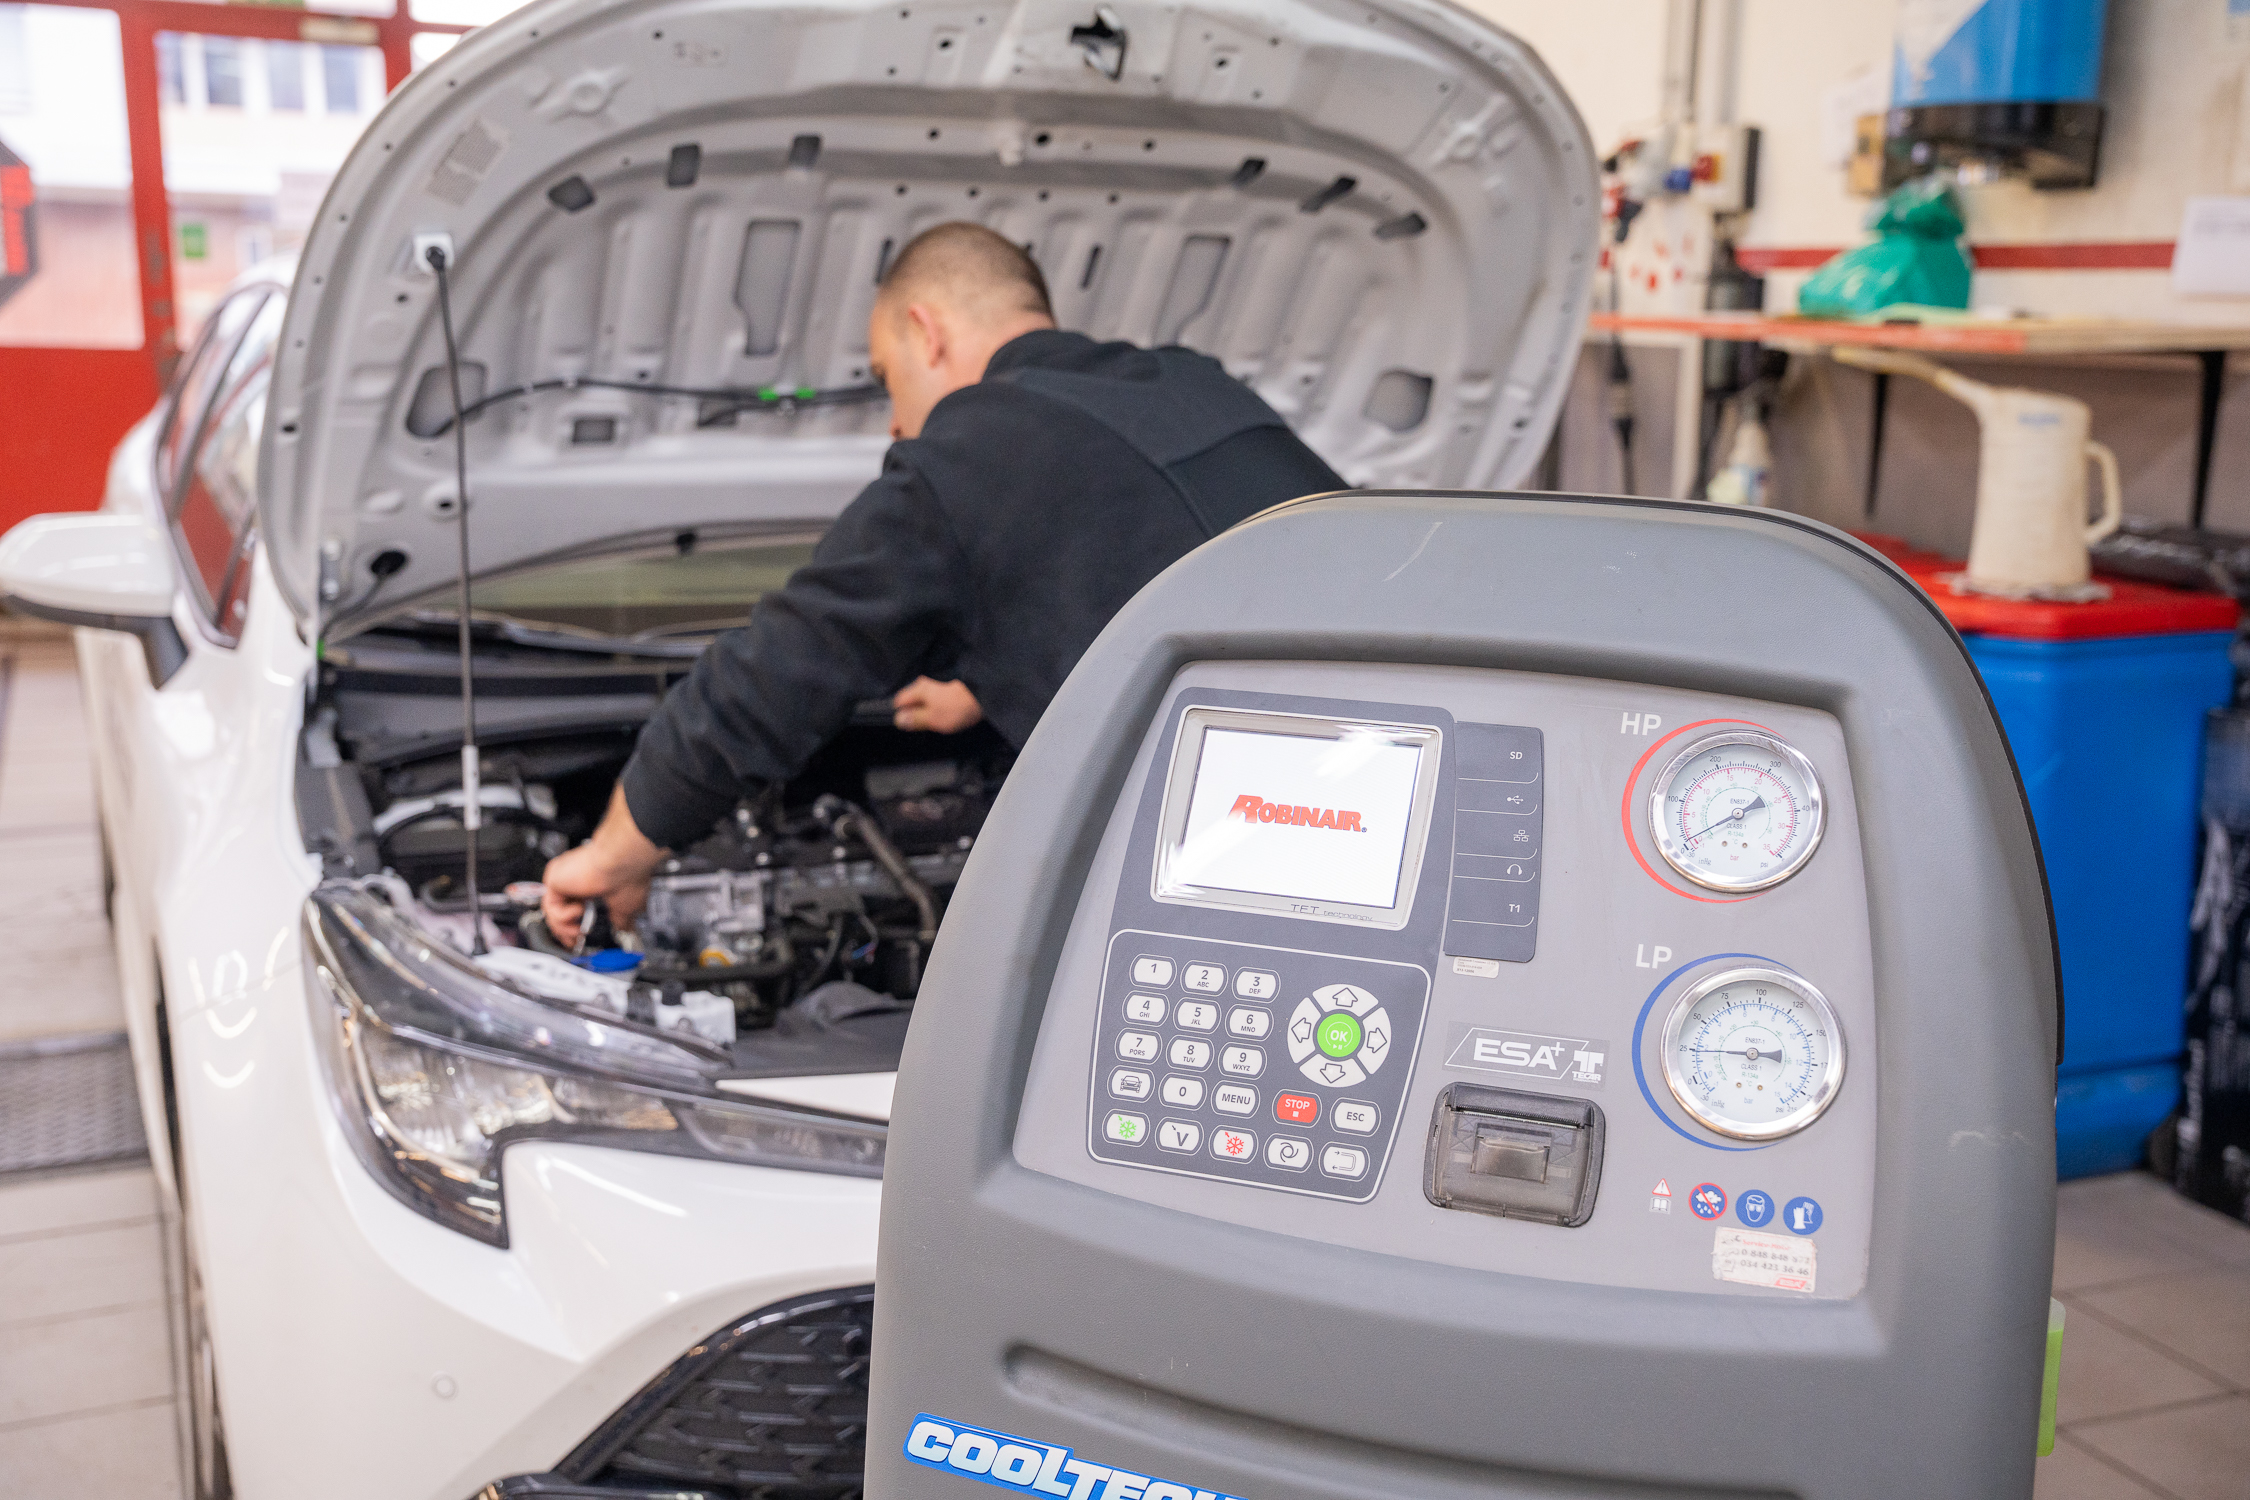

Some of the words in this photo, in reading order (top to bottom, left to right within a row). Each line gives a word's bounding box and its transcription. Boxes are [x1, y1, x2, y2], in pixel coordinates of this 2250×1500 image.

[1620, 712, 1662, 735] HP
[1227, 795, 1361, 832] ROBINAIR
[1509, 904, 1520, 913] T1
[1636, 944, 1672, 969] LP
[1151, 963, 1157, 973] 1
[1201, 970, 1209, 980] 2
[1253, 976, 1260, 986] 3
[1143, 1000, 1150, 1010] 4
[1194, 1007, 1201, 1017] 5
[1246, 1014, 1254, 1024] 6
[1330, 1030, 1348, 1043] OK
[1136, 1037, 1143, 1047] 7
[1187, 1045, 1194, 1055] 8
[1239, 1052, 1247, 1062] 9
[1222, 1093, 1250, 1105] MENU
[1285, 1098, 1310, 1110] STOP
[1711, 1100, 1724, 1108] inHg
[1346, 1112, 1364, 1122] ESC
[1176, 1132, 1189, 1146] V
[907, 1421, 1243, 1500] COOLTE
